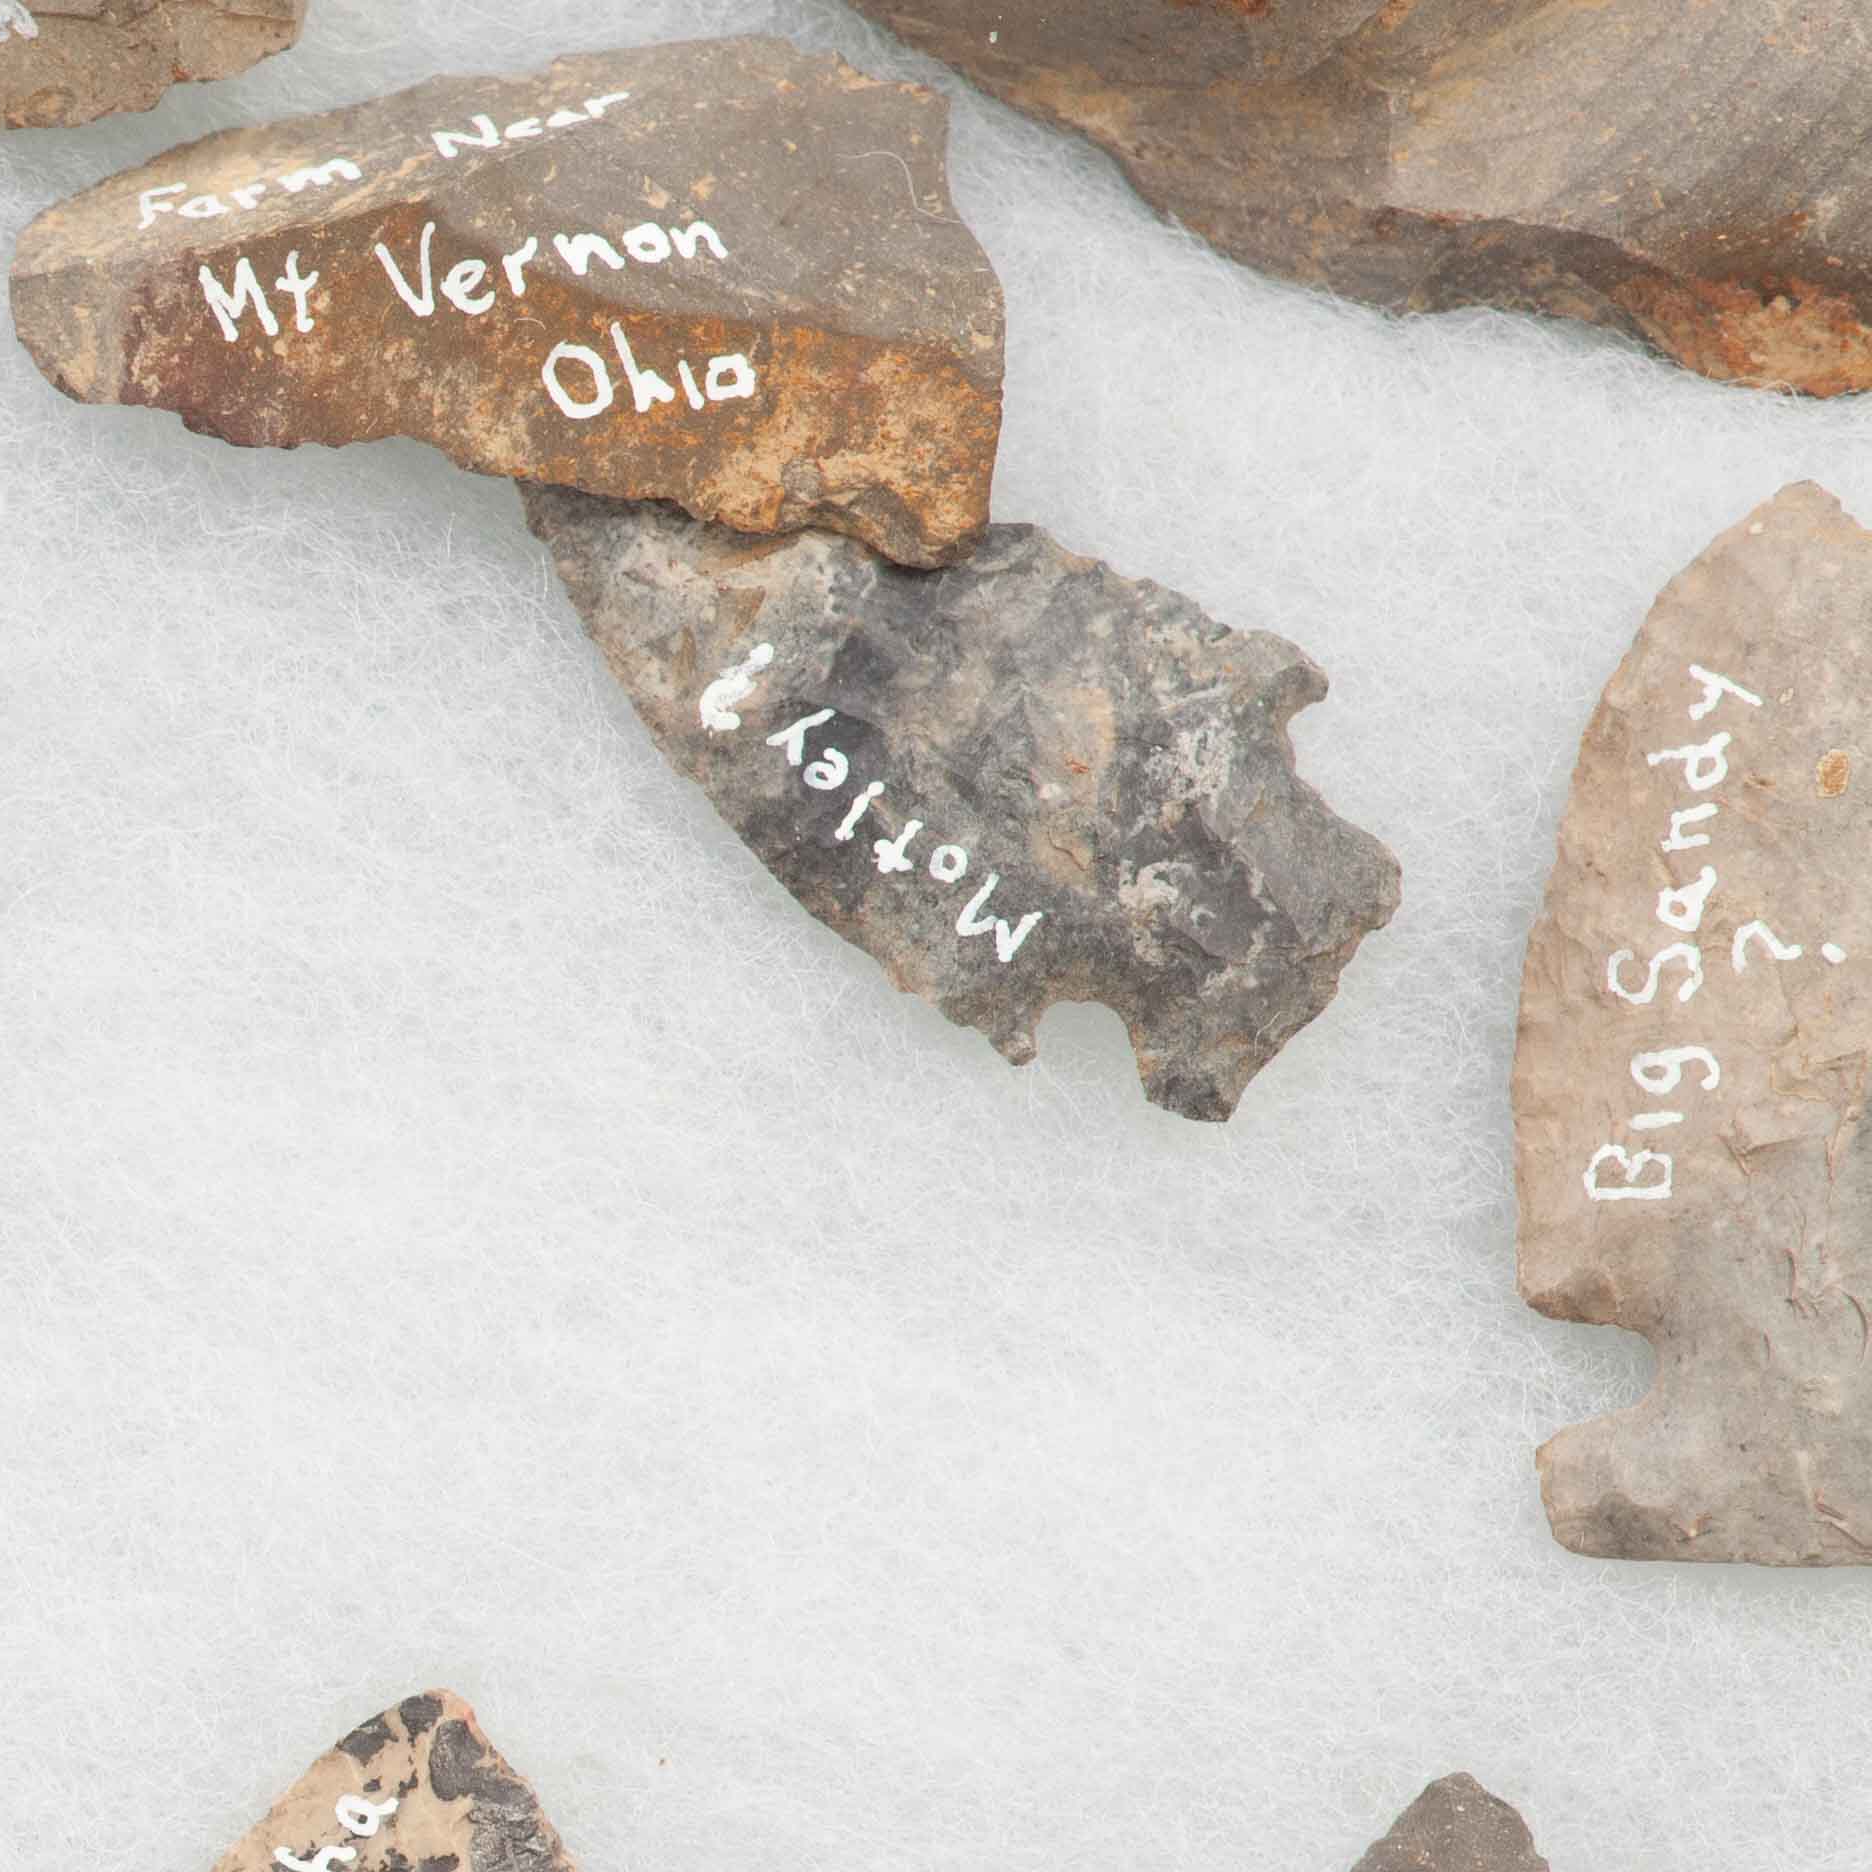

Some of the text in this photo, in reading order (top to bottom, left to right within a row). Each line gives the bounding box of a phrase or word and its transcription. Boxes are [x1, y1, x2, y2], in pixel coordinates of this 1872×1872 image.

[134, 152, 363, 232] Farm
[196, 219, 731, 344] Mt Vernon
[540, 322, 758, 421] Ohio
[1581, 663, 1765, 1203] Big Sandy
[1731, 918, 1848, 975] ?
